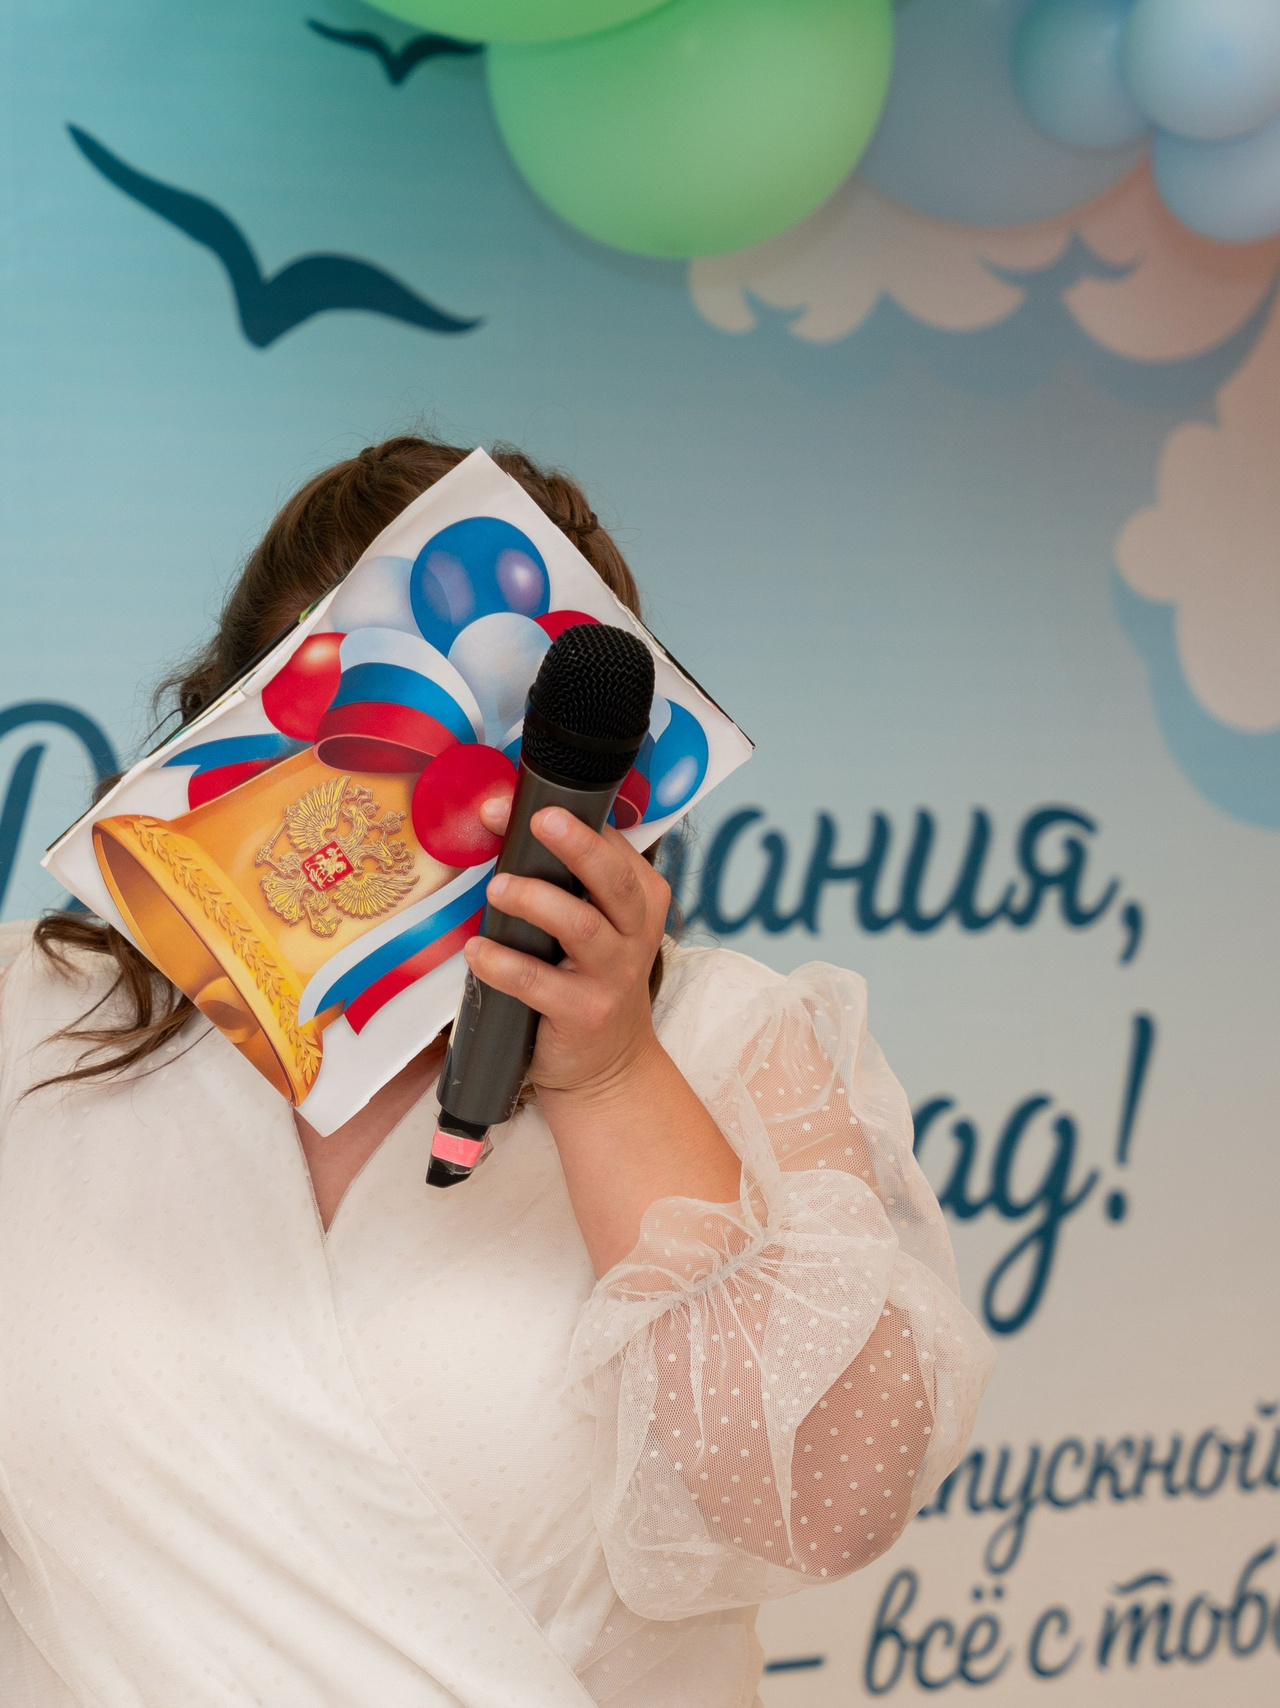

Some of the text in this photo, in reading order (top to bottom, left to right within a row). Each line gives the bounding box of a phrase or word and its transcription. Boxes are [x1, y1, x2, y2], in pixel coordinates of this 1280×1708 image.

[665, 803, 1144, 966] ания,
[912, 1012, 1156, 1337] ад!
[918, 1400, 1280, 1575] пускной
[865, 1567, 1012, 1696] всё
[1028, 1605, 1082, 1679] с
[1094, 1541, 1280, 1673] тоб
